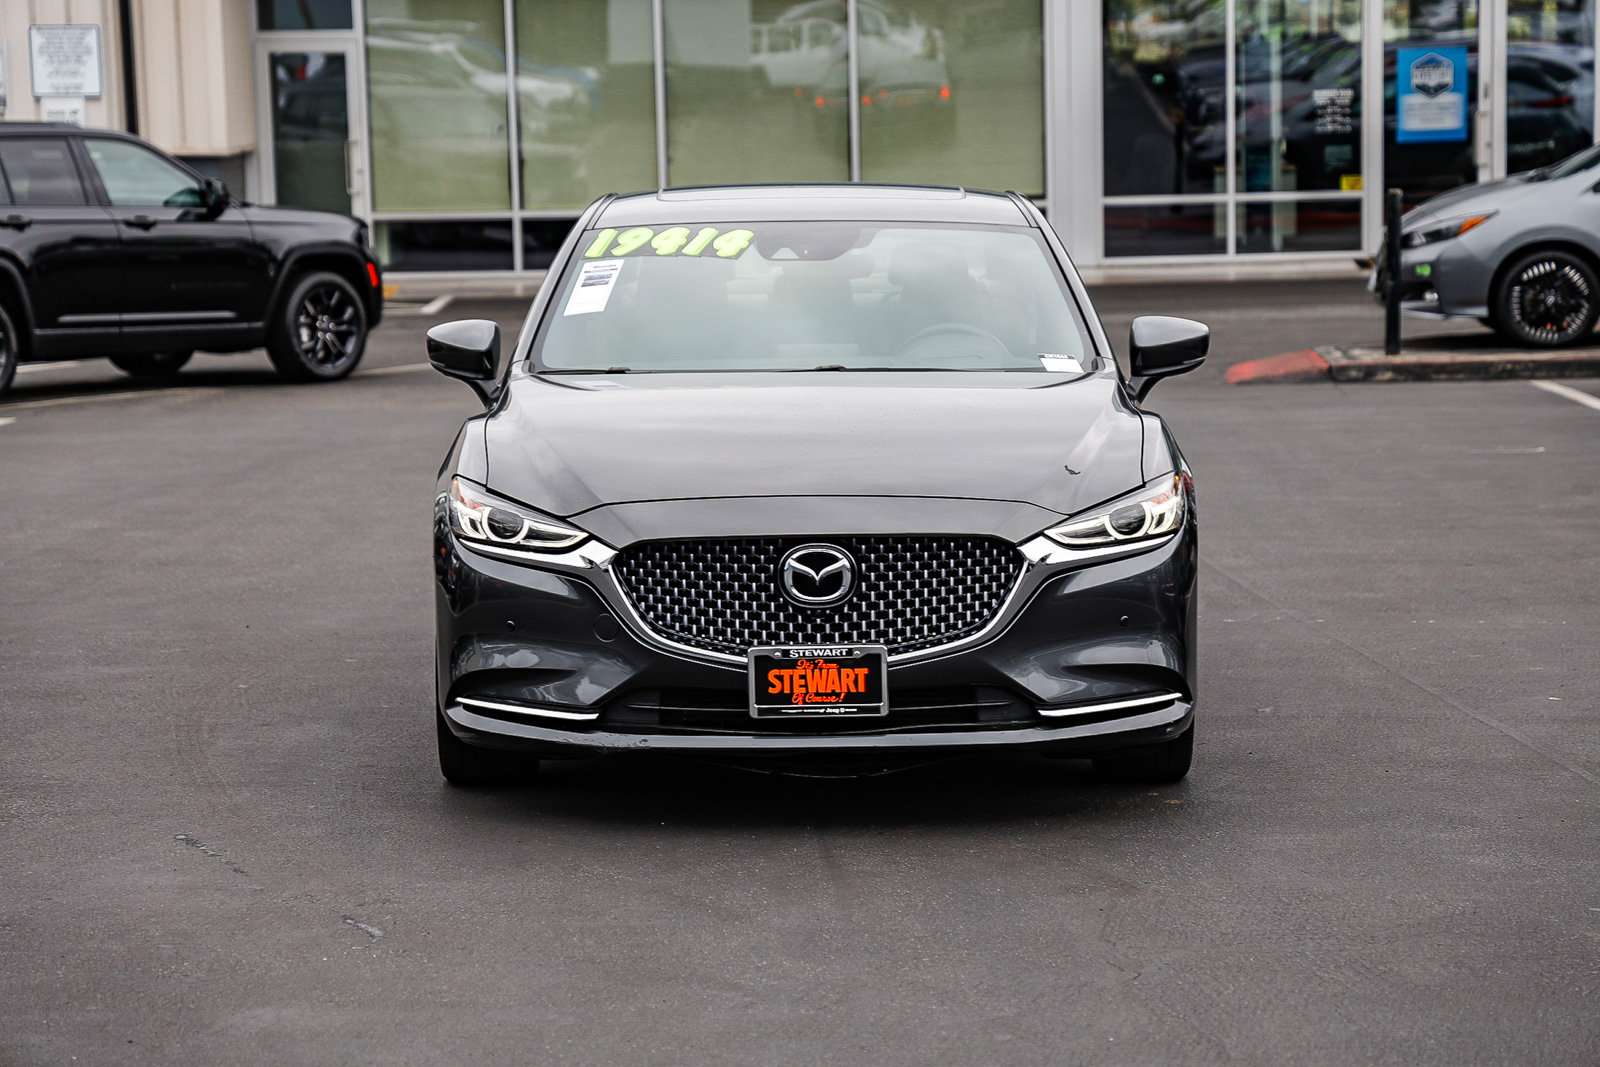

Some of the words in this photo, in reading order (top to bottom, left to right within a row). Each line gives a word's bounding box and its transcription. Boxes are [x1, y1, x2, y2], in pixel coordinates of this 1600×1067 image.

[584, 226, 755, 257] 19414
[789, 648, 848, 658] STEWART
[815, 659, 839, 669] From
[767, 668, 869, 694] STEWART
